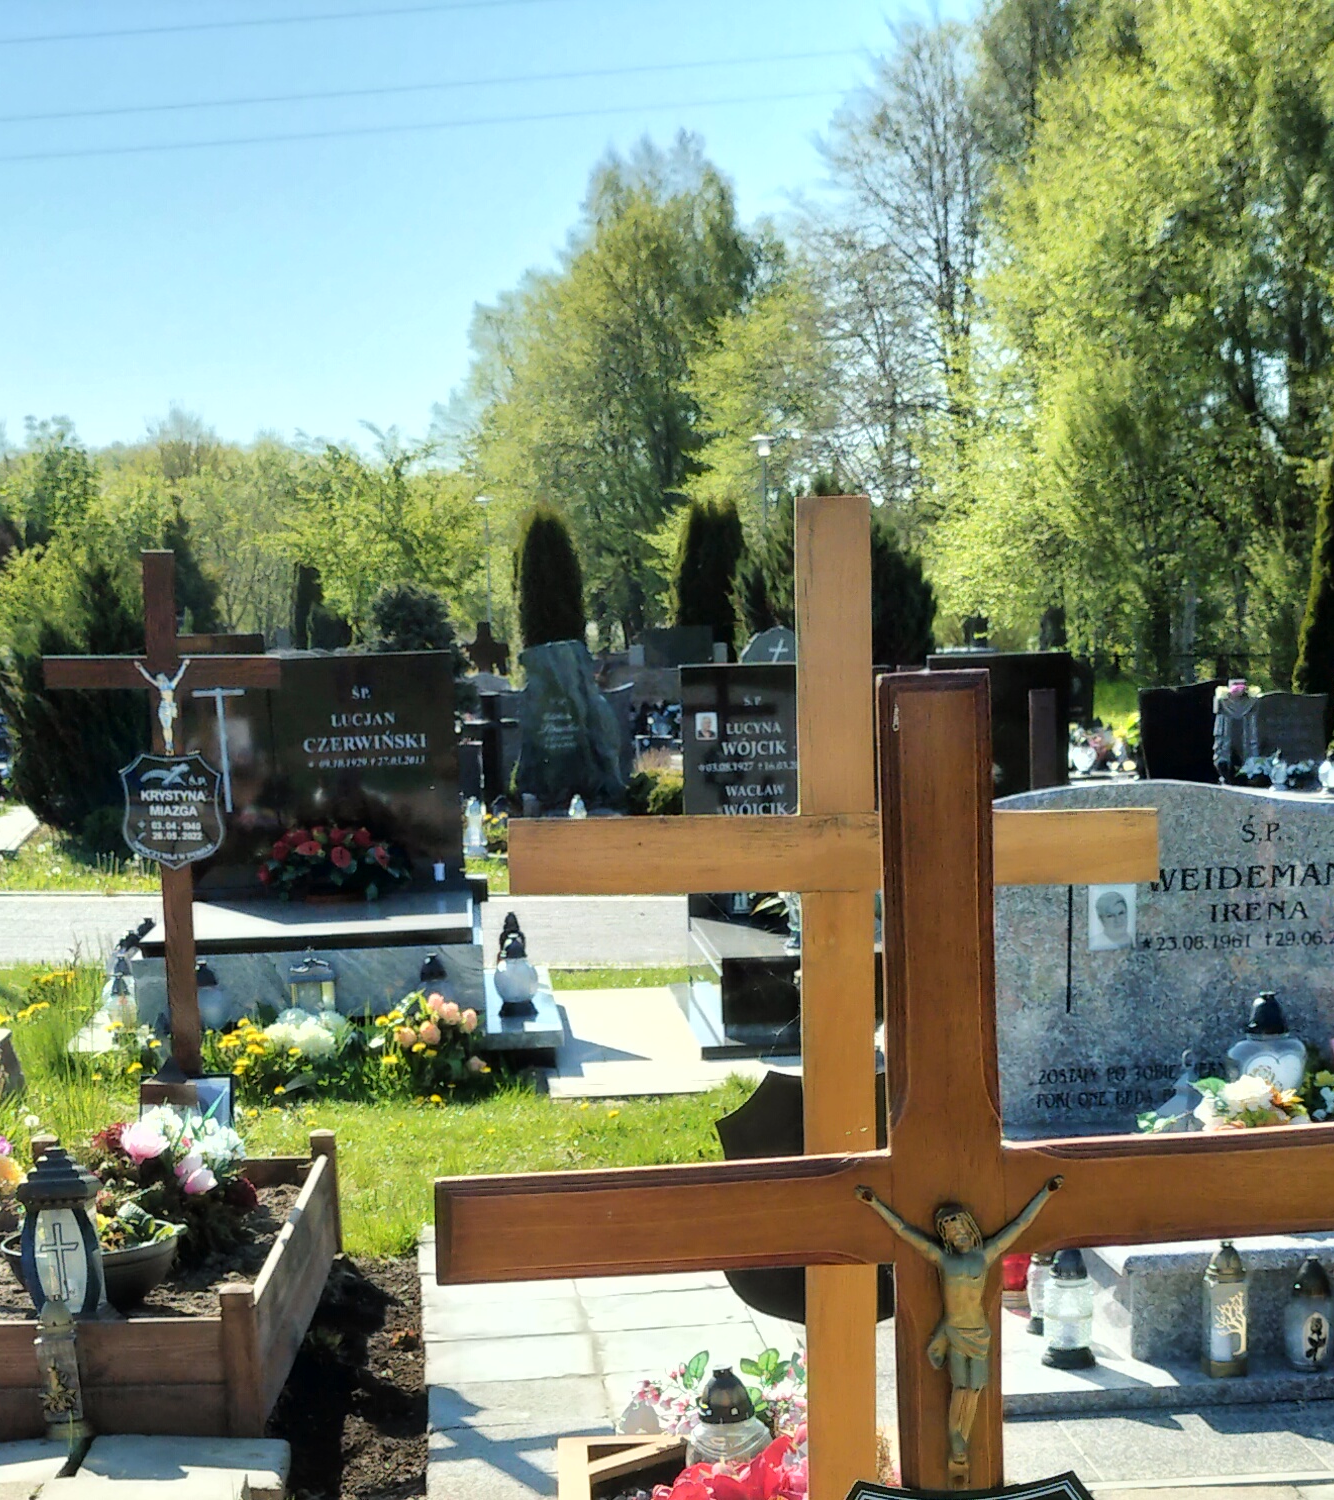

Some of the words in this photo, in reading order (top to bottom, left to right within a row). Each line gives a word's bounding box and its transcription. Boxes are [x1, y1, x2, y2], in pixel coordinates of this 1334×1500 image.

[330, 712, 396, 728] LUCJAN
[725, 722, 782, 735] LUCYNA
[302, 730, 427, 753] CZERWIŃSKI
[721, 737, 787, 758] WÓJCIK
[140, 789, 207, 802] KRYSTYNA
[148, 804, 199, 817] MIAZGA
[1241, 815, 1283, 843] Ś.P.
[1209, 900, 1309, 923] IRENA
